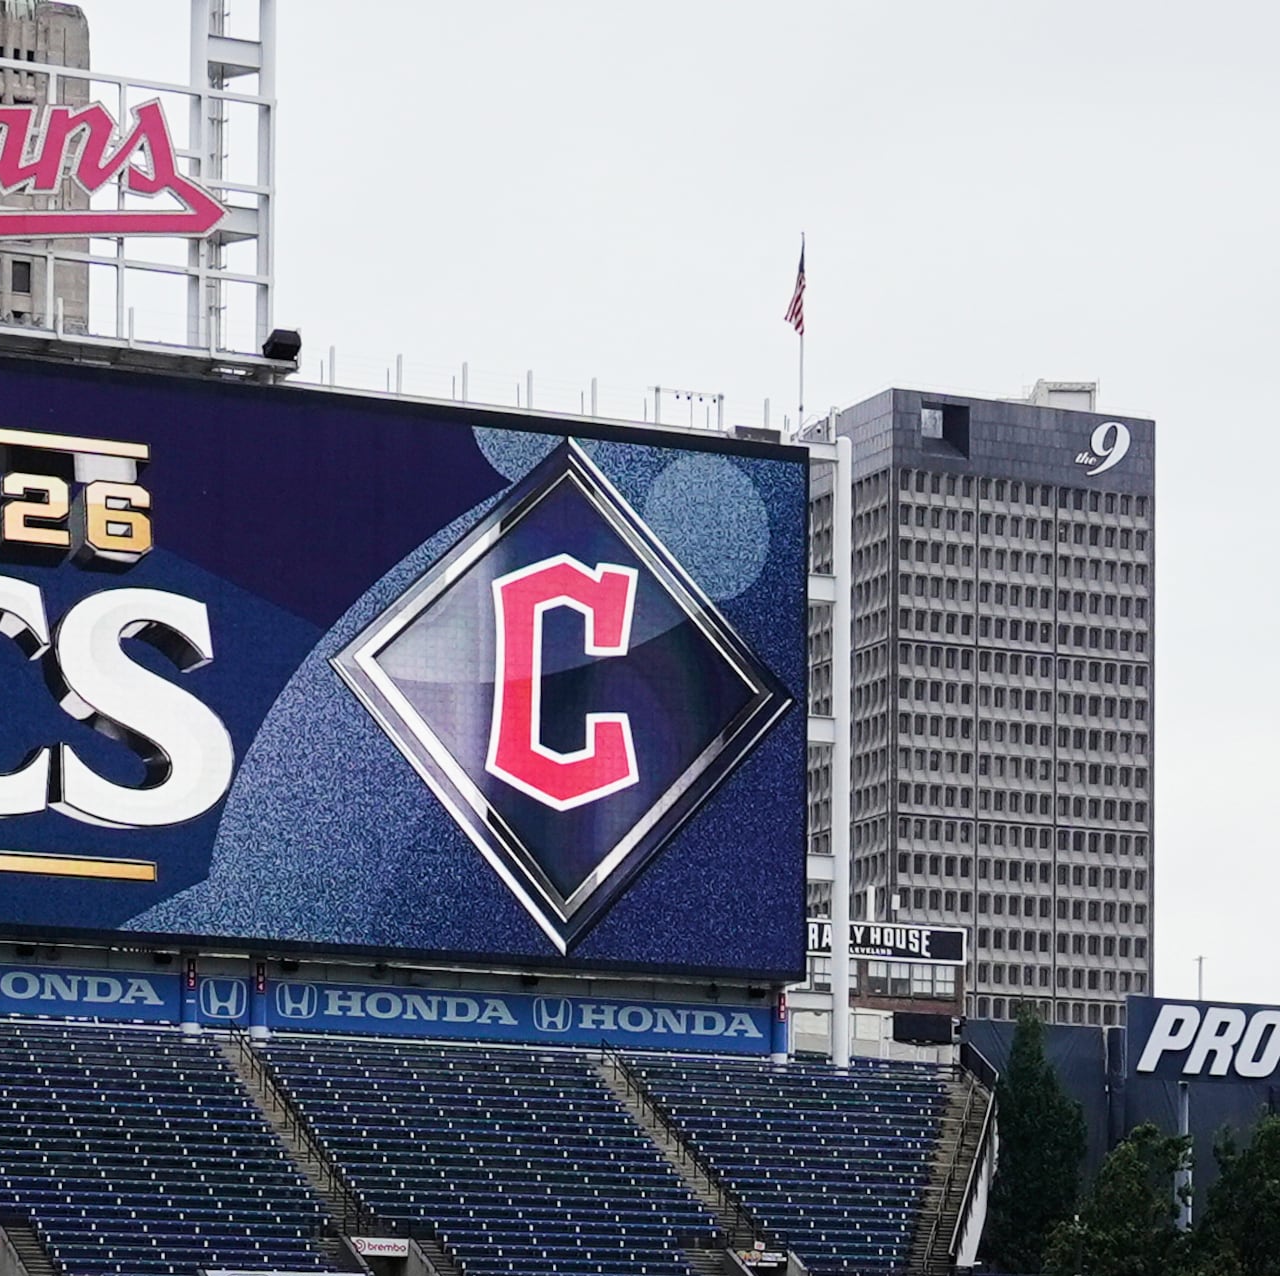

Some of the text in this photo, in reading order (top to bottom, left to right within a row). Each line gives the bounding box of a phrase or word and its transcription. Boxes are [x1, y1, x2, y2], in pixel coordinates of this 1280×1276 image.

[1074, 421, 1131, 476] the 9
[485, 552, 640, 812] C
[808, 923, 932, 958] RAY HOUSE
[850, 946, 893, 956] LEVELAND
[323, 990, 518, 1026] HONDA
[577, 1003, 763, 1039] HONDA
[367, 1242, 407, 1252] brembo
